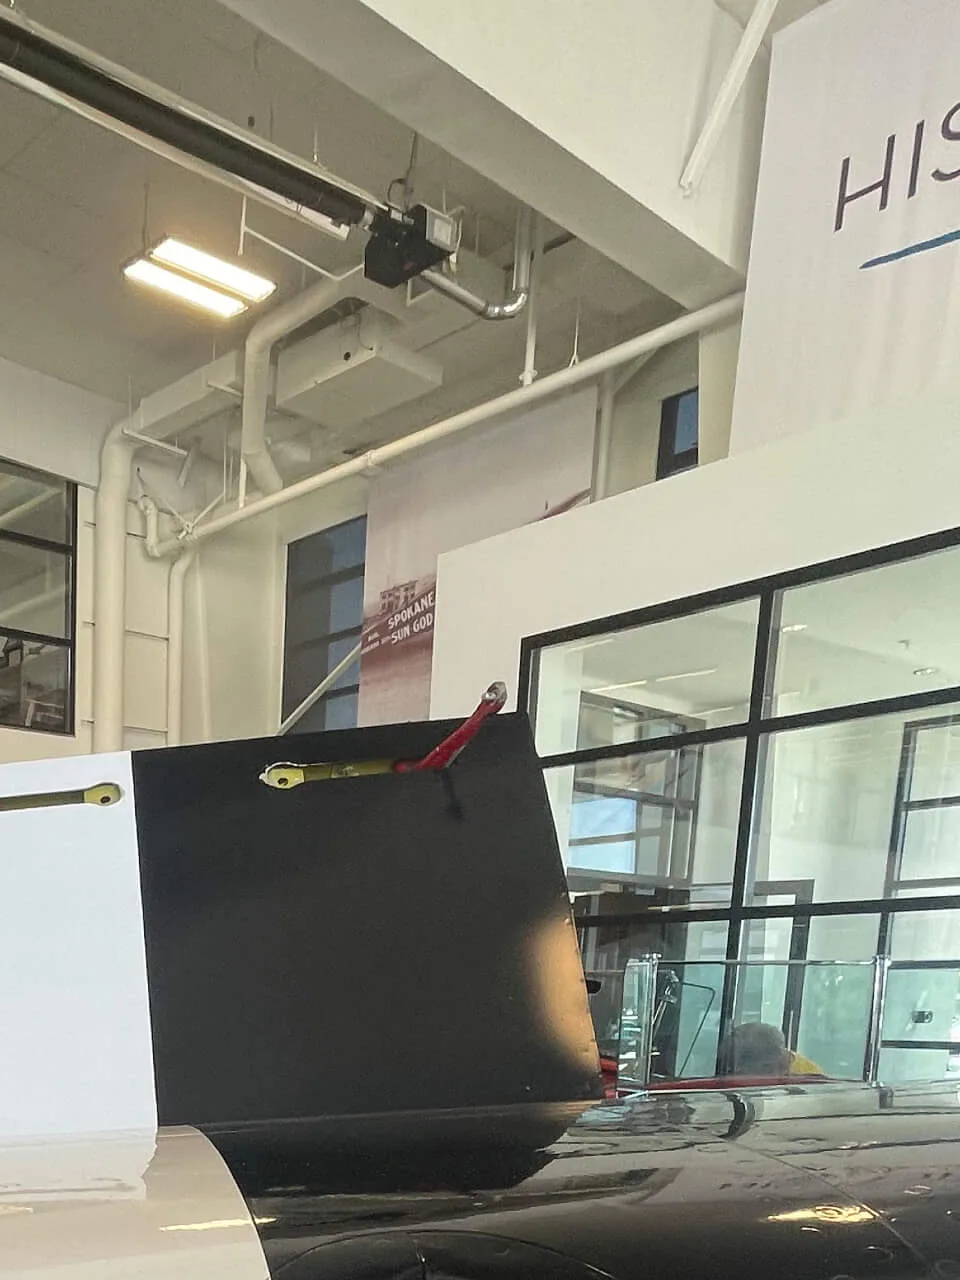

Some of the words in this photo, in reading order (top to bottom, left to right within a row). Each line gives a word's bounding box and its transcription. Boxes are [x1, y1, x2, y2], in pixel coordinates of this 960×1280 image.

[387, 591, 435, 629] SPOKANE
[391, 626, 410, 644] SUN
[412, 612, 434, 633] GOD
